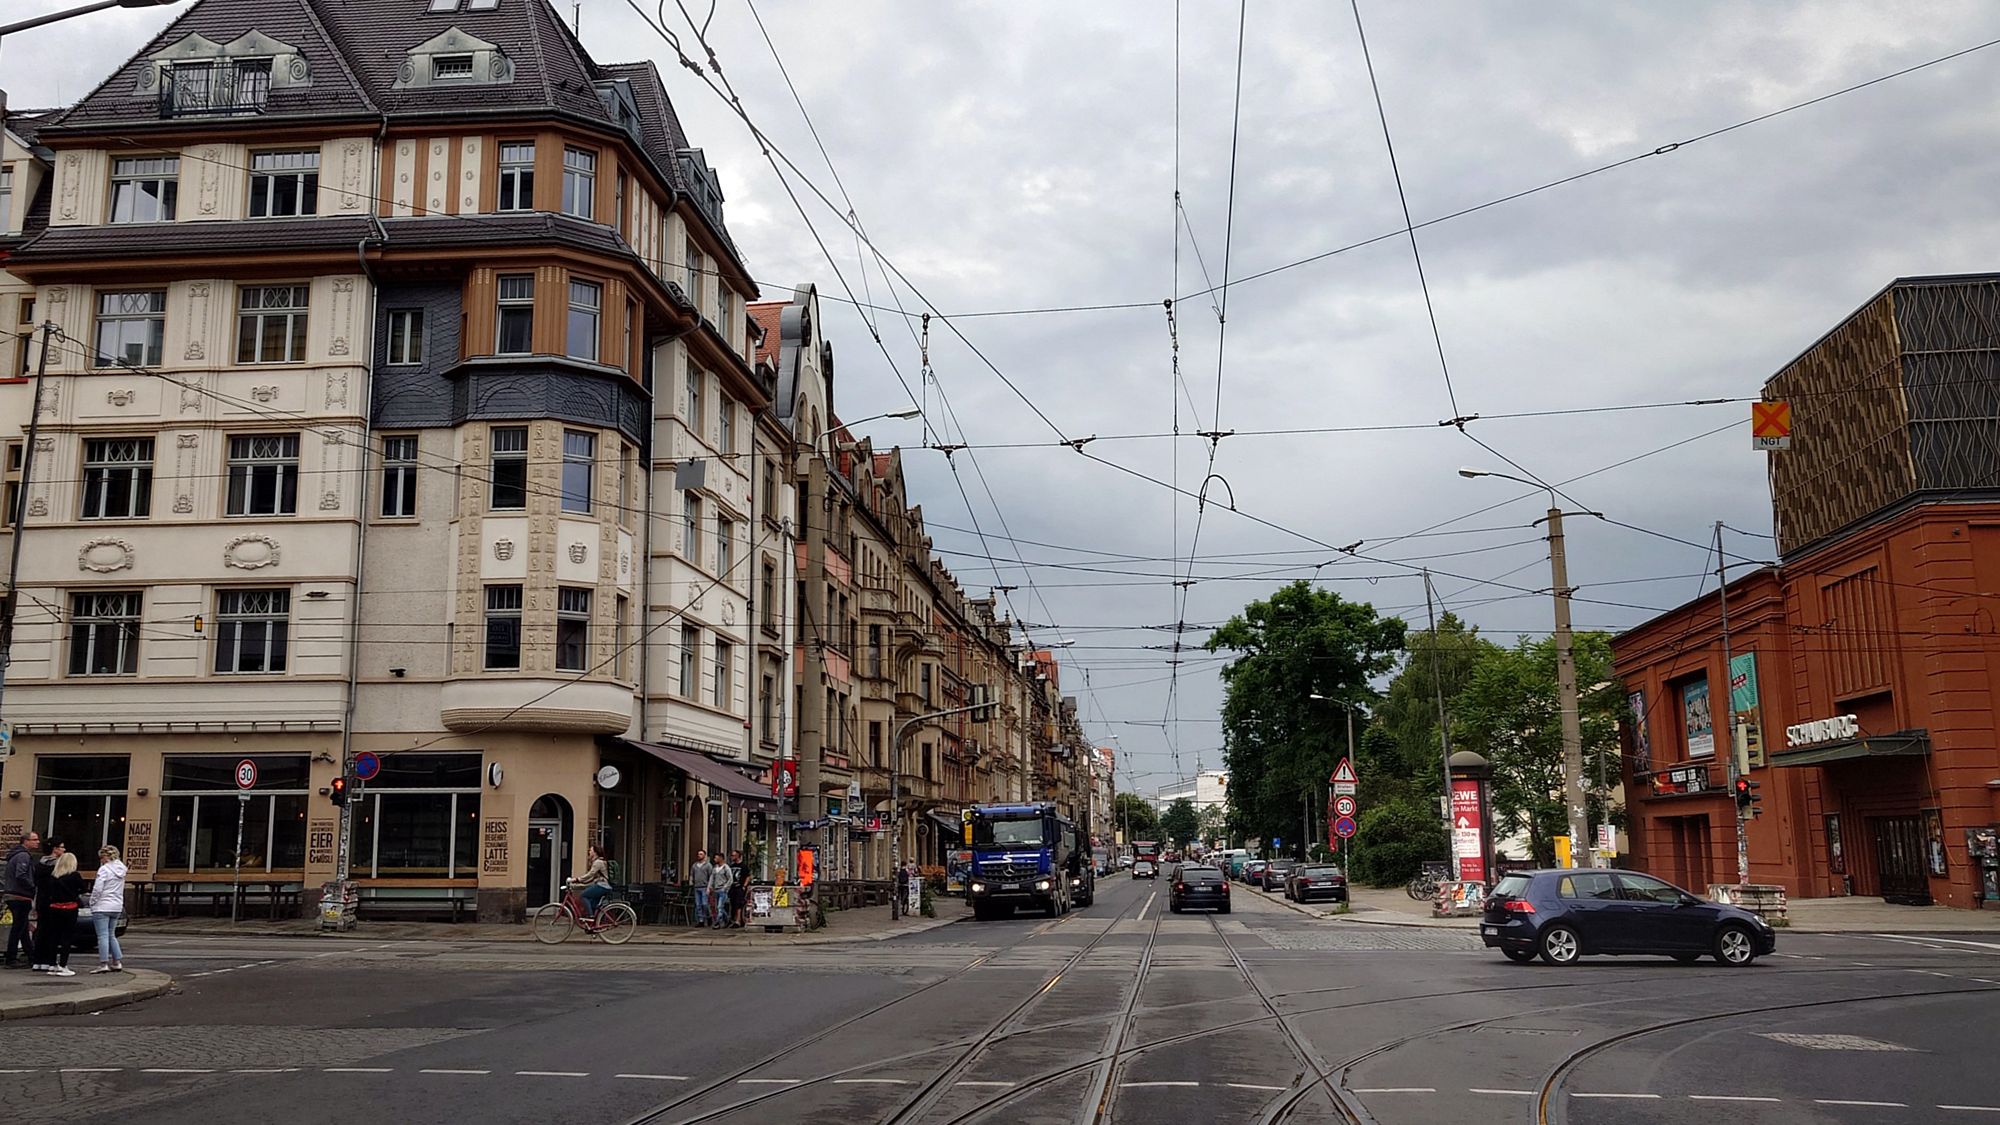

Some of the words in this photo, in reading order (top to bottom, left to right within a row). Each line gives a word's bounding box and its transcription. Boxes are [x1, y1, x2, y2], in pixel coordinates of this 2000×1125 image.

[1761, 437, 1781, 446] NGT
[1786, 714, 1859, 747] SCHAUBURG
[240, 767, 252, 781] 30
[1452, 790, 1478, 800] EWE
[1339, 802, 1352, 812] 30
[1, 823, 23, 835] SÜSSE
[129, 823, 152, 835] NACH
[485, 821, 508, 833] HEISS
[310, 832, 333, 848] EIER
[127, 847, 151, 858] EISTEE
[484, 848, 509, 860] LATTE
